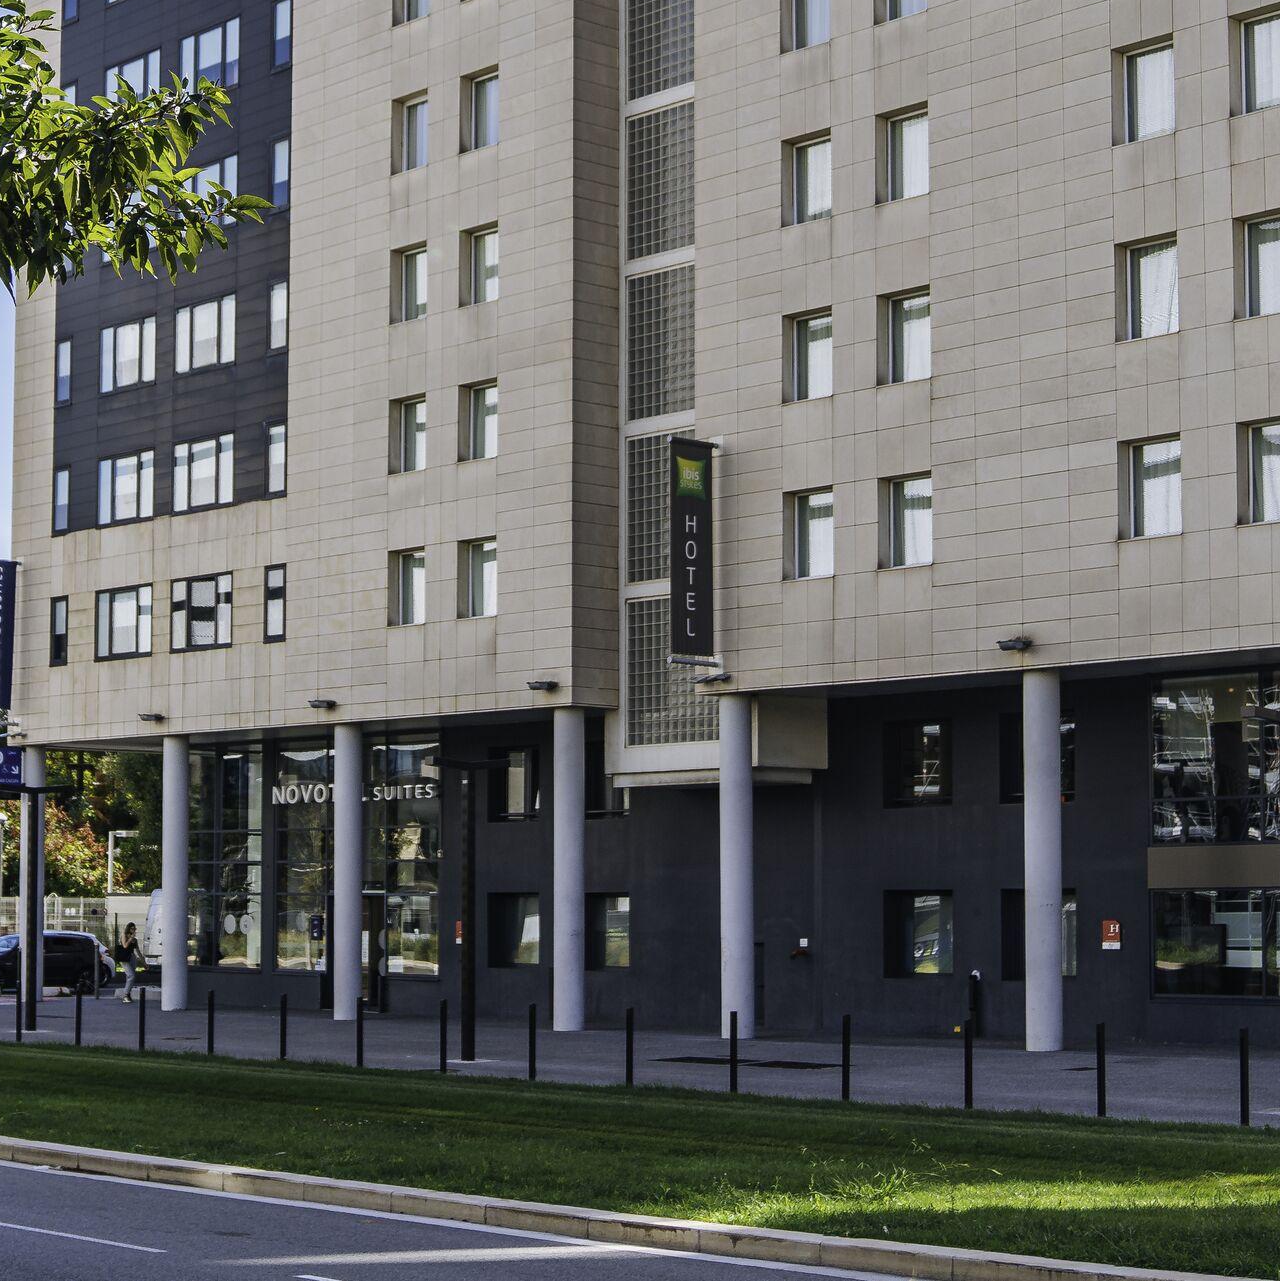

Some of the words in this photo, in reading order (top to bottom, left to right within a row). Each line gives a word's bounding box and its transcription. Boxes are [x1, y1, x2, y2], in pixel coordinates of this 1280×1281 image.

[683, 466, 700, 480] ibis
[685, 515, 697, 637] HOTEL
[272, 783, 370, 805] NOVOL
[373, 783, 435, 801] SUITES
